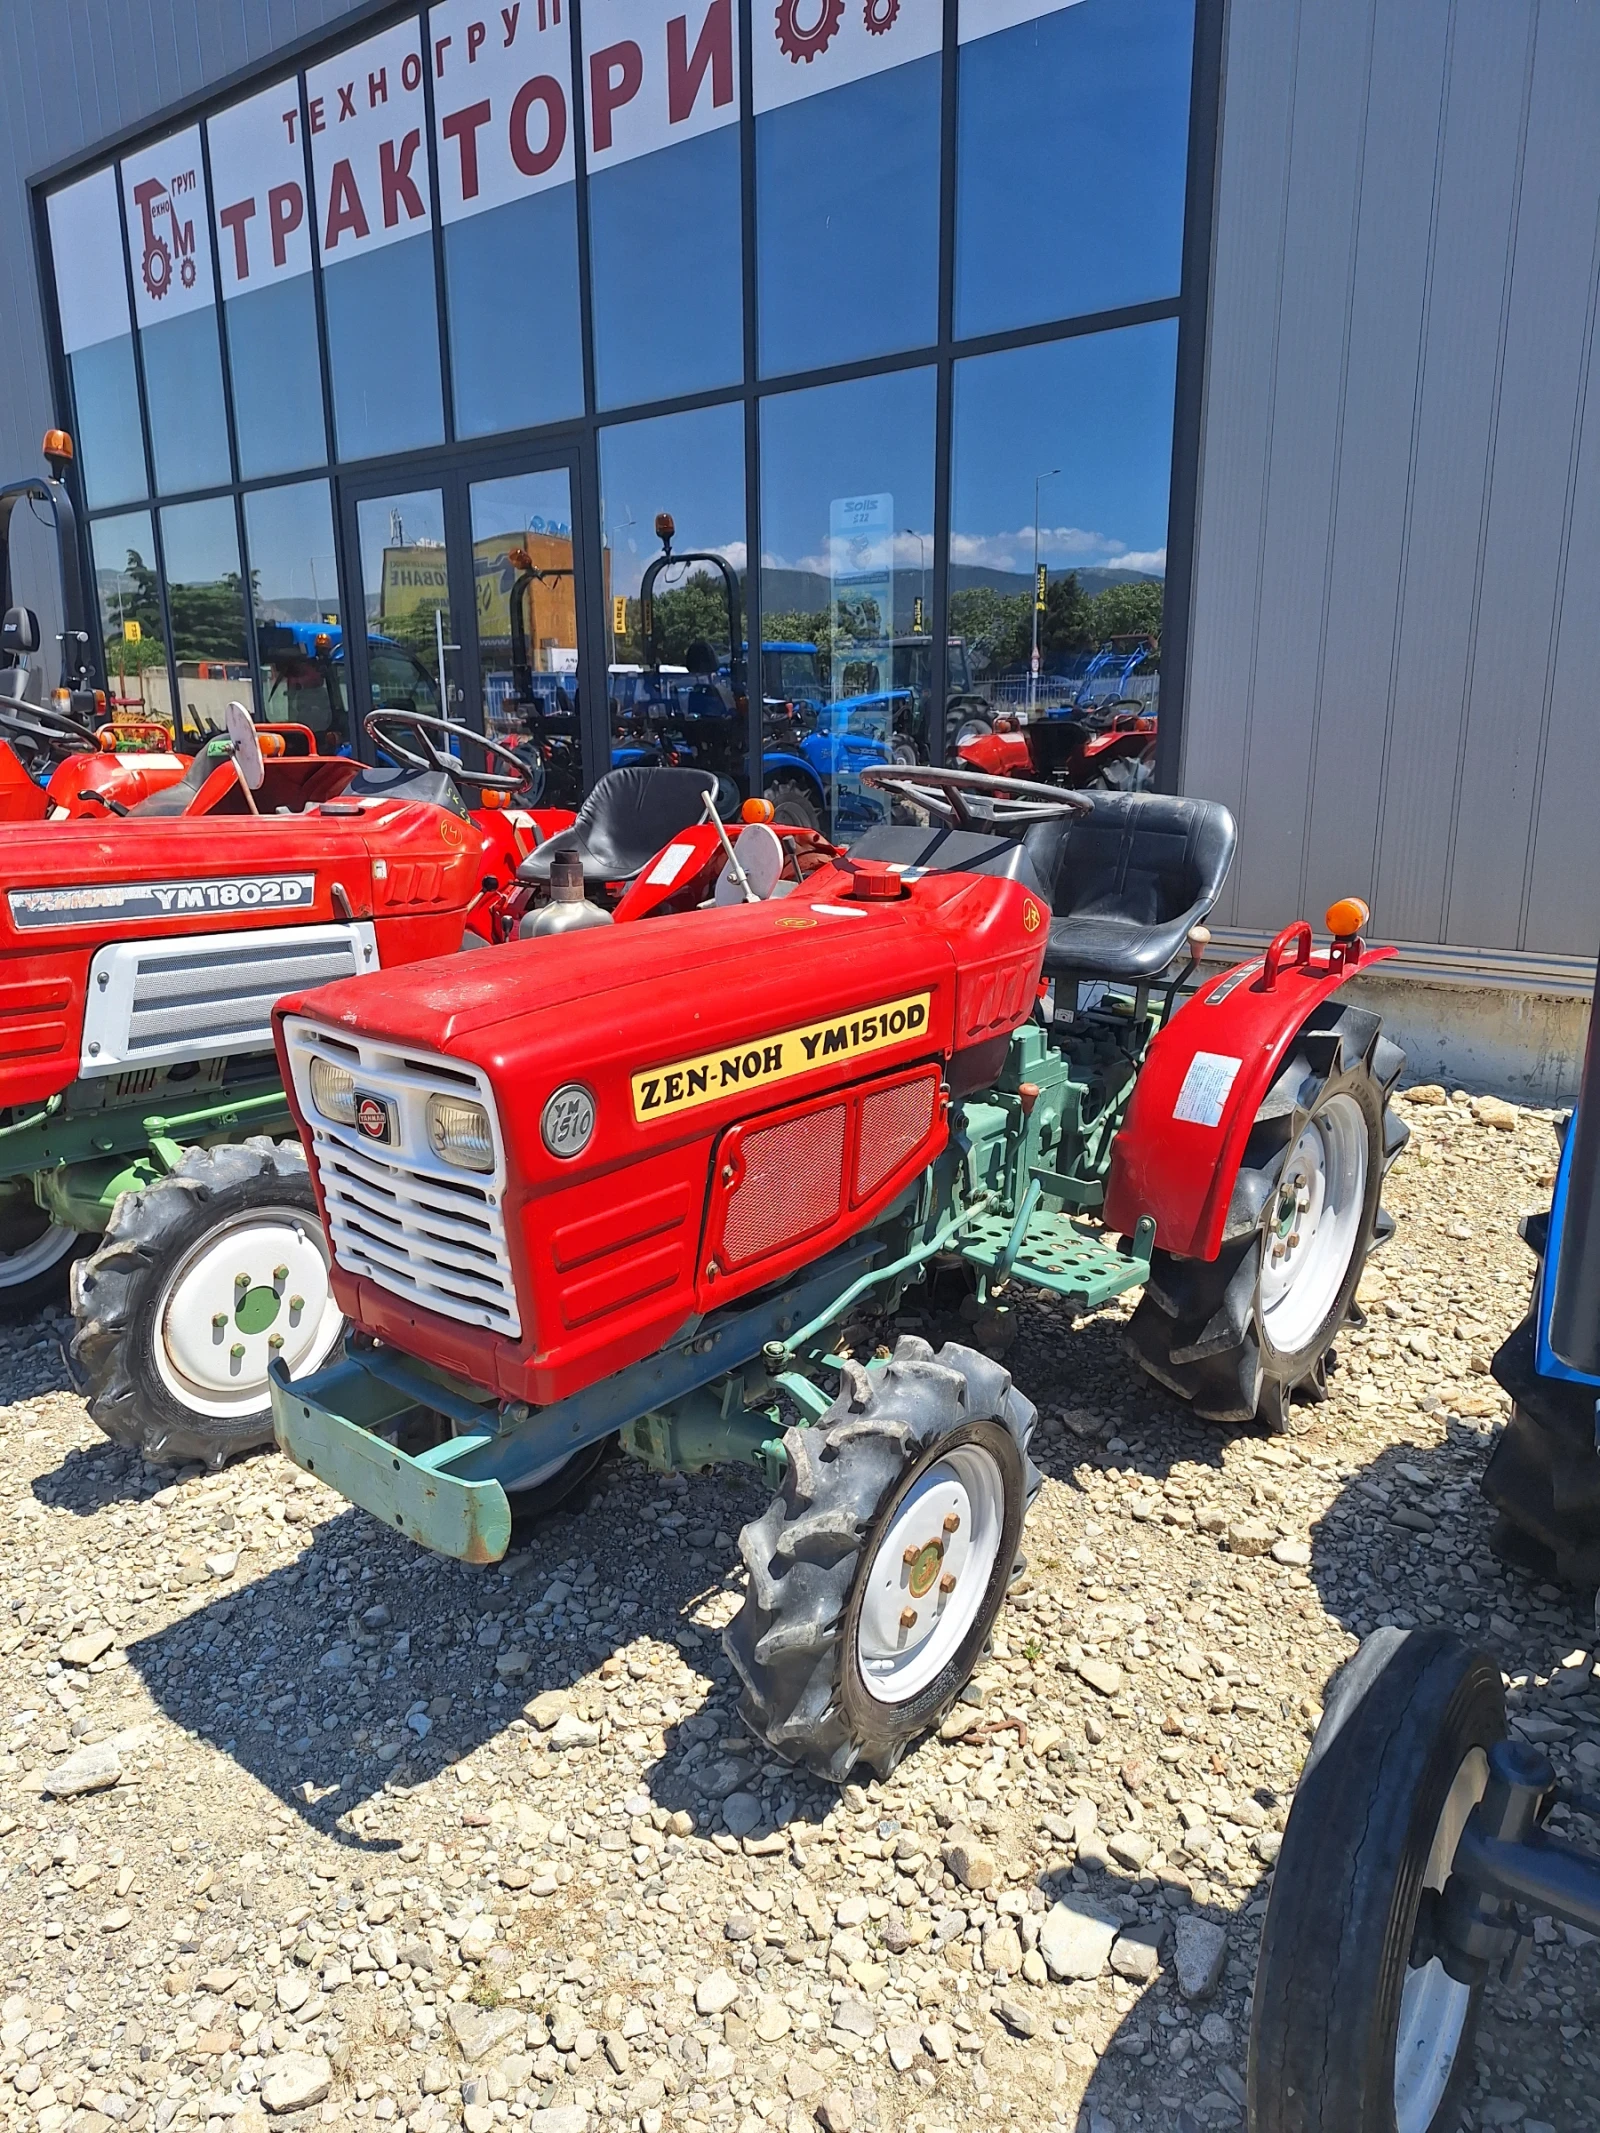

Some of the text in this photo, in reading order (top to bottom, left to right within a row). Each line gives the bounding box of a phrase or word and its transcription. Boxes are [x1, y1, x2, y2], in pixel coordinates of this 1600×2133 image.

[220, 0, 734, 280] ТРАКТОРИ
[171, 169, 196, 197] ГРУП
[151, 880, 303, 910] YM1802D
[640, 1003, 926, 1111] ZEN-NOH YM1510D
[359, 1113, 386, 1123] YANMAR
[554, 1097, 580, 1118] YM
[551, 1108, 591, 1144] 1510
